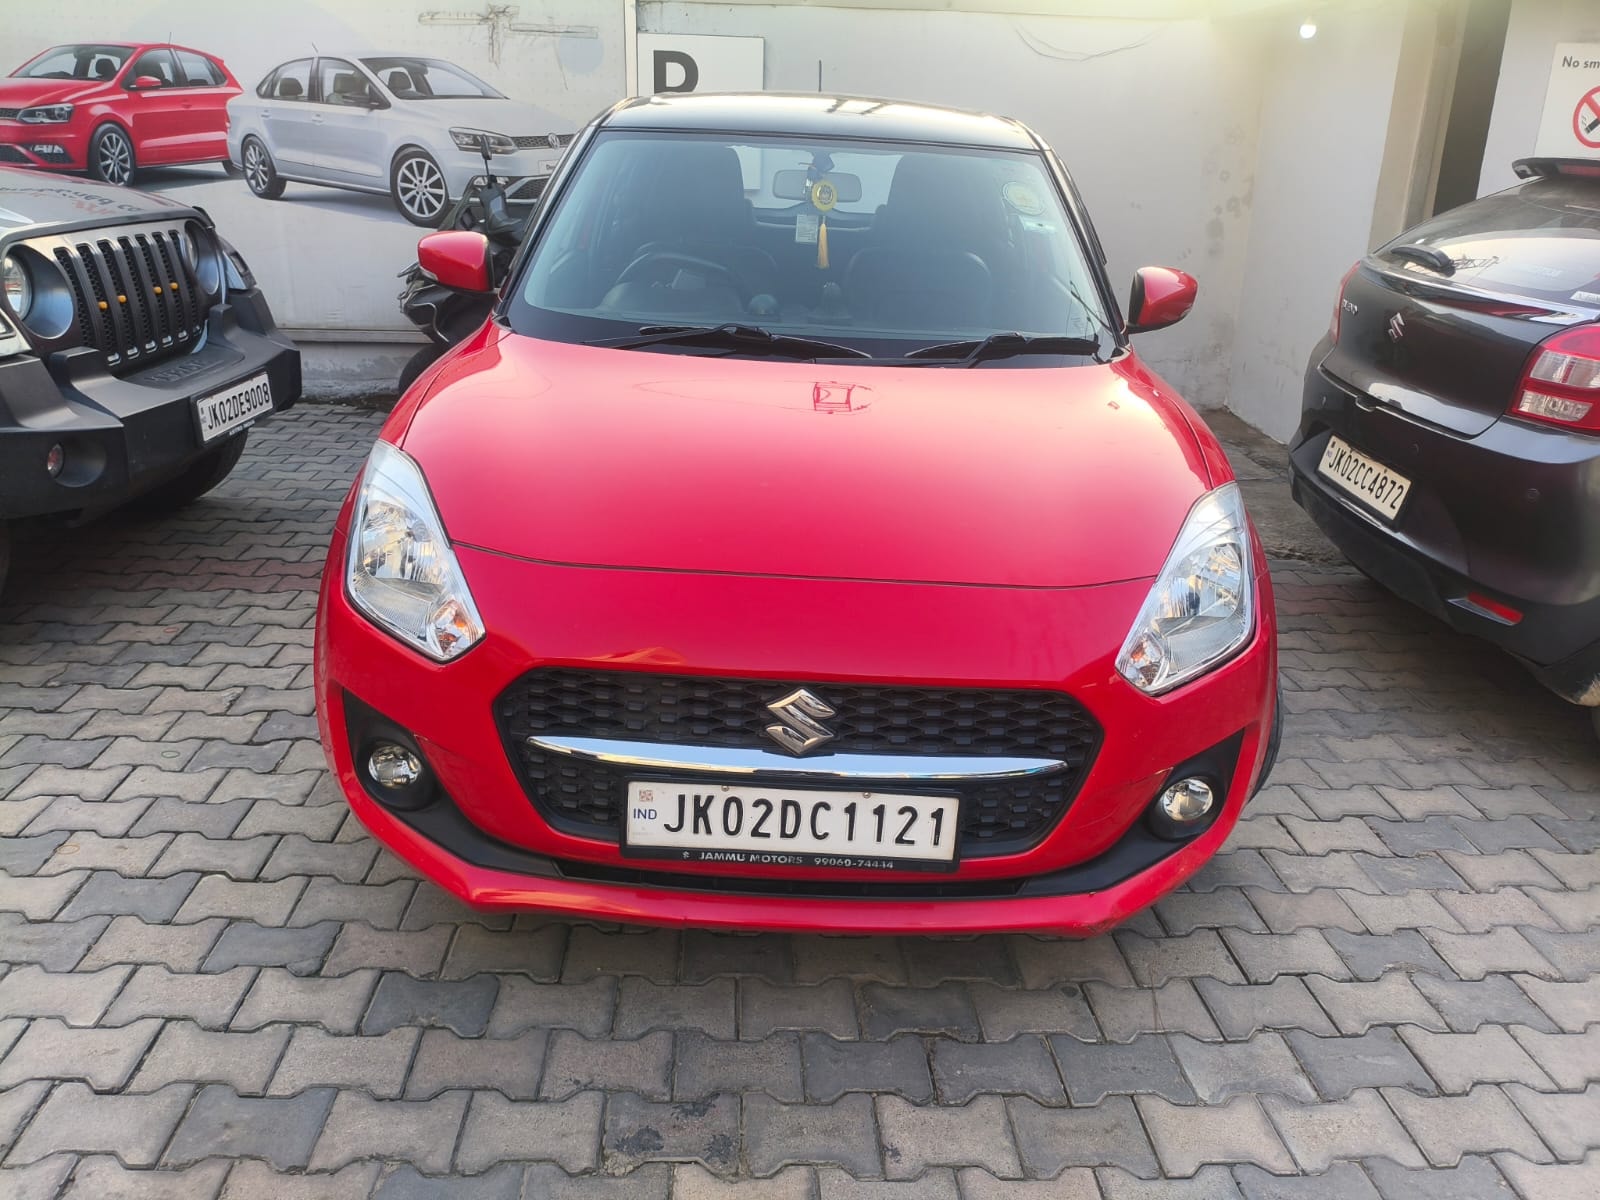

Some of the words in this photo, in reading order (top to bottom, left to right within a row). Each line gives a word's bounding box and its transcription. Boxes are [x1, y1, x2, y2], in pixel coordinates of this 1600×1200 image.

[1562, 56, 1580, 68] No
[208, 382, 270, 430] JK02DE9008
[1328, 447, 1404, 510] JK02CC4872
[633, 808, 658, 821] IND
[664, 794, 944, 846] JK02DC1121
[699, 852, 746, 862] JAMMU
[749, 854, 803, 865] MOTORS
